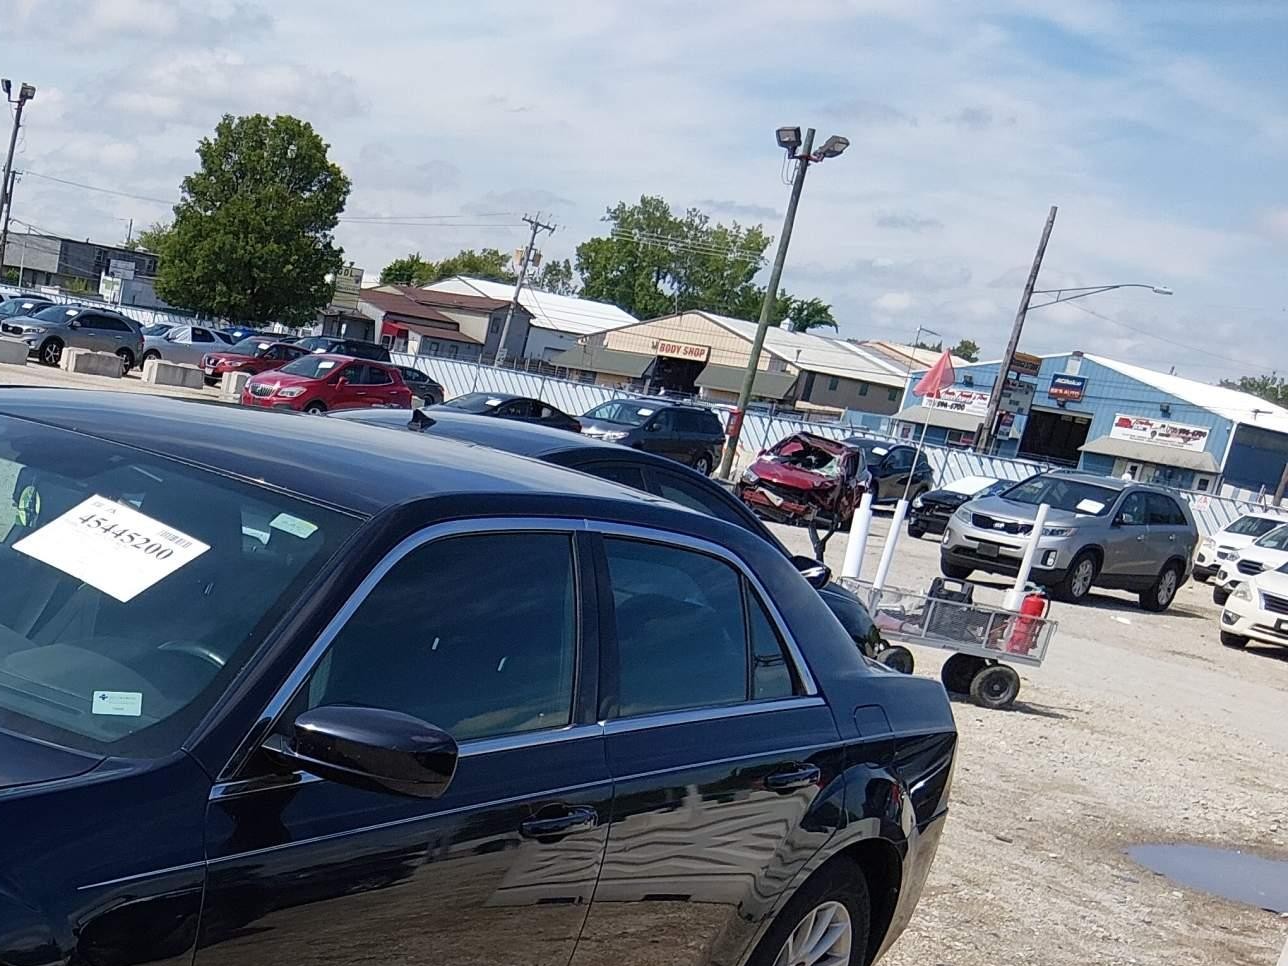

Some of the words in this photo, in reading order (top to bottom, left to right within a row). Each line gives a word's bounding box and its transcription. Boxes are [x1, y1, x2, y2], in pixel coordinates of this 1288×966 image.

[659, 343, 681, 354] BODY
[682, 346, 706, 358] SHOP
[78, 513, 175, 560] 45445200
